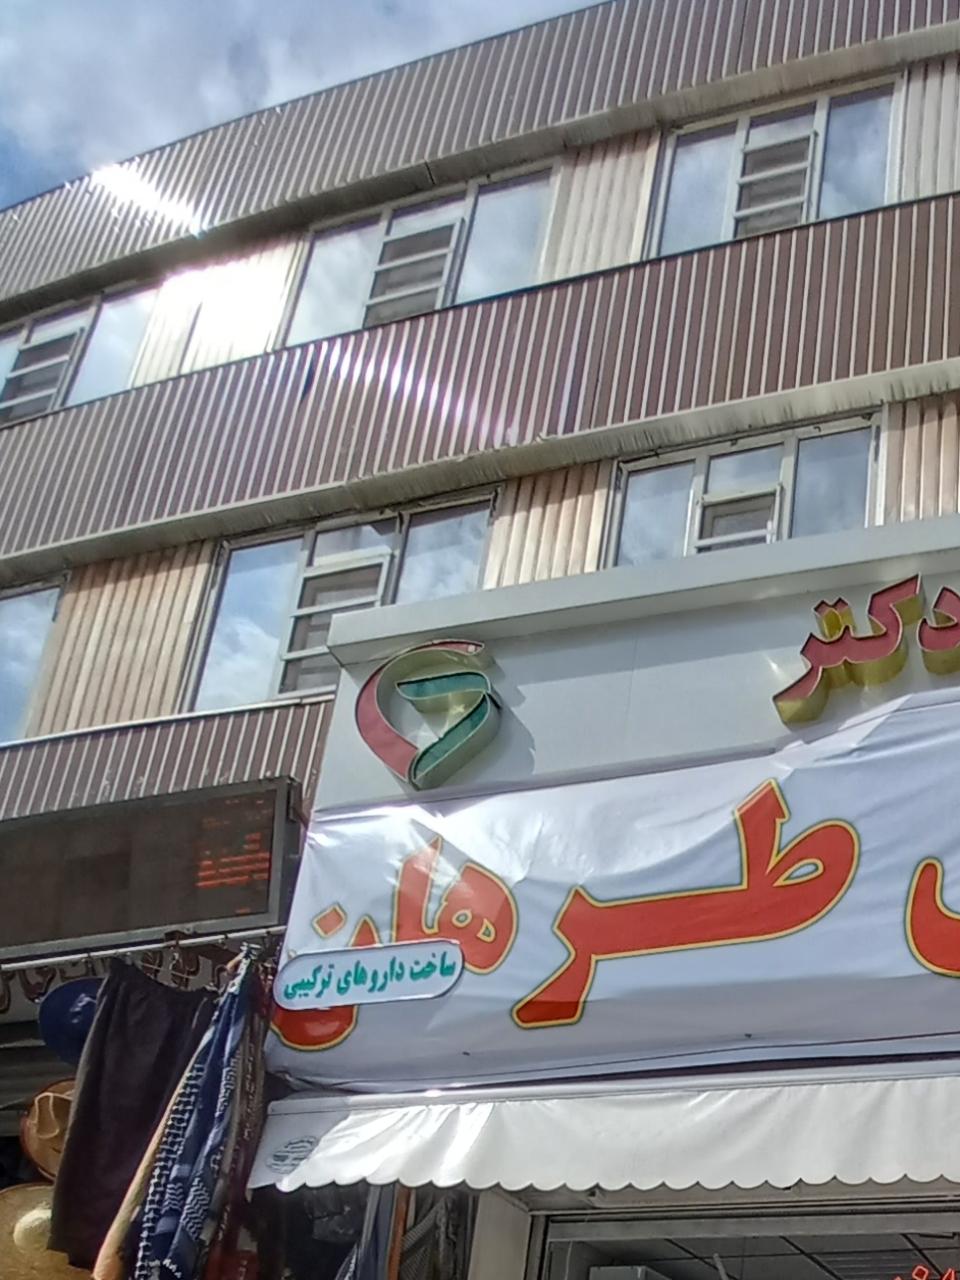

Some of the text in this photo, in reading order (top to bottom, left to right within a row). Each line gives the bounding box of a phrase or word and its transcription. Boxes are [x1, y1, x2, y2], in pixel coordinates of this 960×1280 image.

[270, 779, 860, 1052] طرهان
[283, 951, 457, 1000] ساخت داروهای ترکیبی
